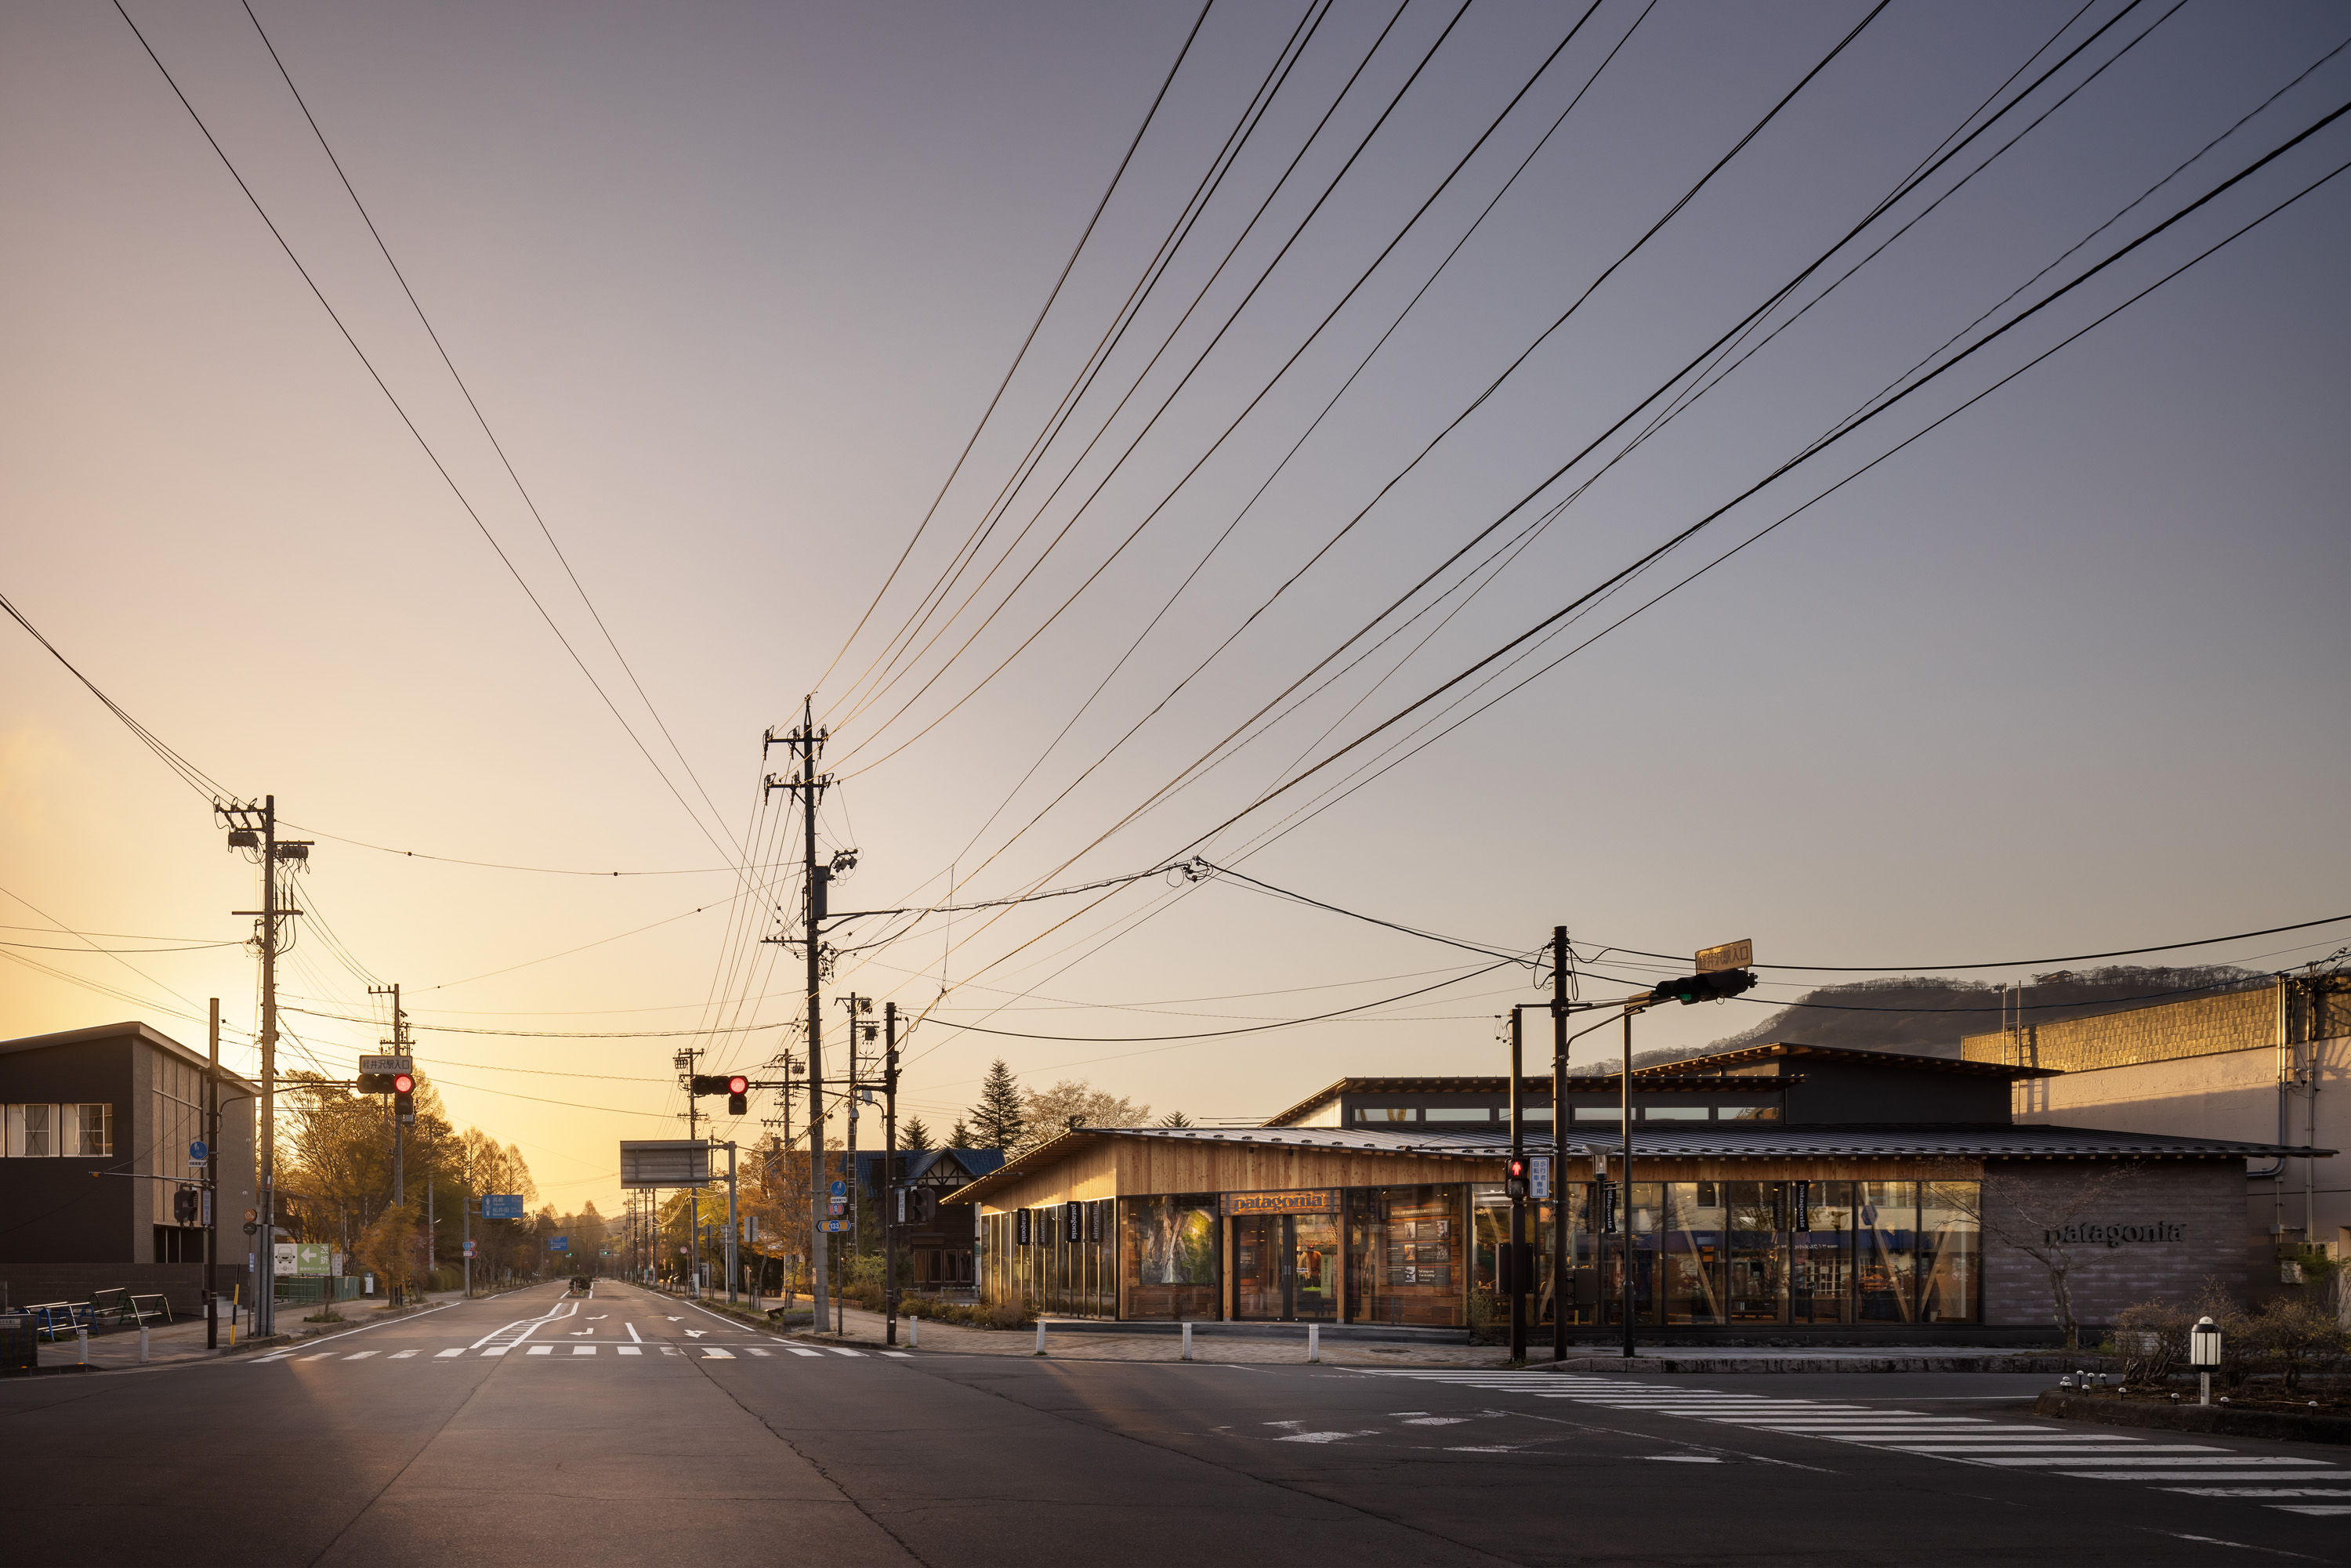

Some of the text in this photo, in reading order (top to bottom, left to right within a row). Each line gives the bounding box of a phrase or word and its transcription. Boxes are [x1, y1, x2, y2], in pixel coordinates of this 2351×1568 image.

[363, 1059, 410, 1070] 軽井沢駅入口
[1233, 1193, 1323, 1212] patagonia
[2045, 1220, 2186, 1248] patagonia
[320, 1245, 328, 1264] 左折
